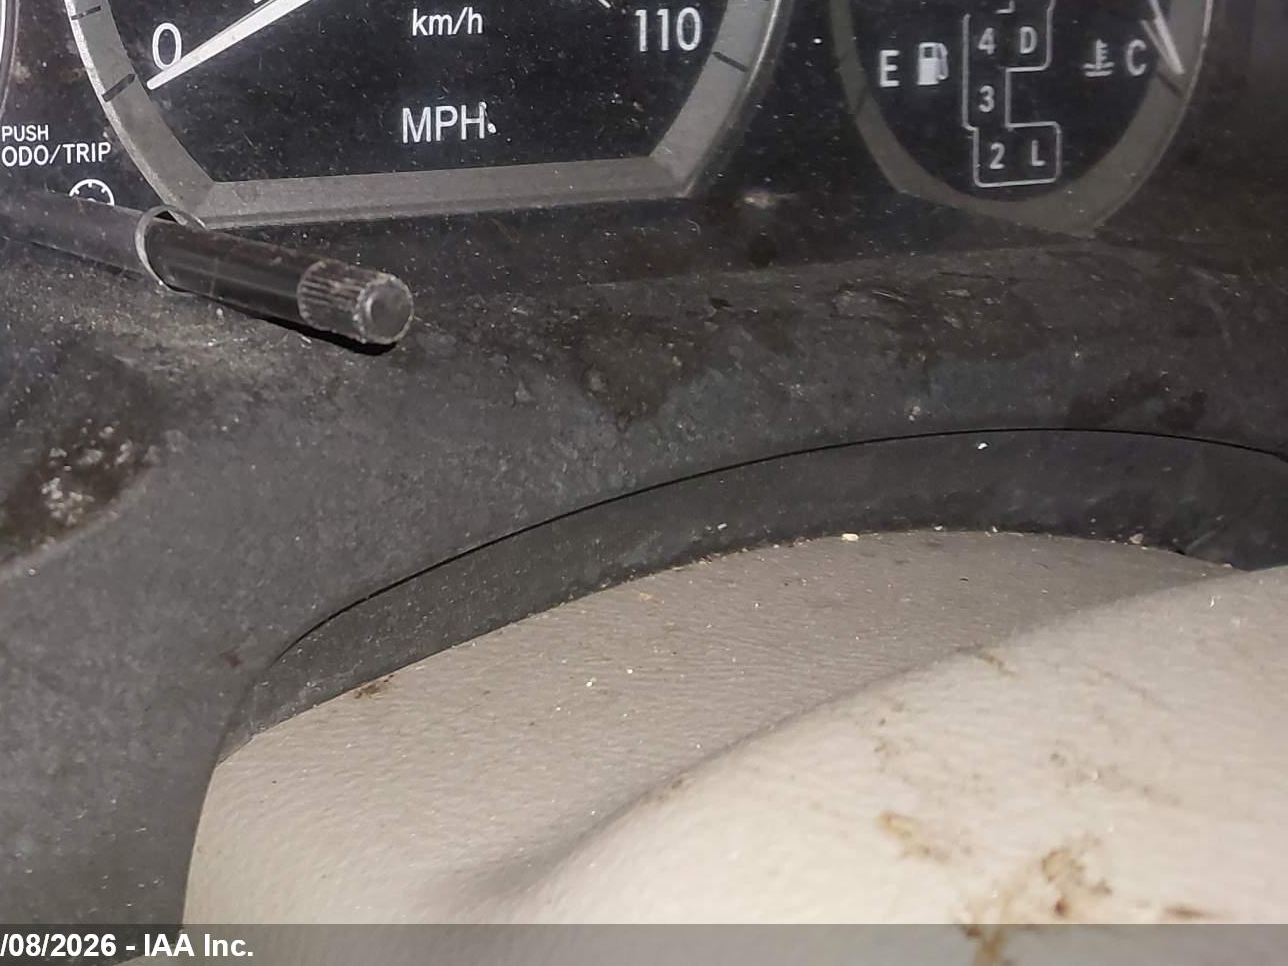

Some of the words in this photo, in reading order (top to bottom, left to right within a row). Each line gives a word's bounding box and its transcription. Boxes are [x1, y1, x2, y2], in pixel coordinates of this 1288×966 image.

[413, 7, 482, 35] km/h
[636, 7, 701, 51] 110
[153, 23, 182, 68] 0
[978, 28, 994, 54] 4
[1020, 27, 1036, 53] D
[880, 50, 899, 86] E
[1127, 40, 1146, 75] C
[979, 86, 993, 112] 3
[2, 125, 49, 142] PUSH
[403, 105, 486, 143] MPH
[2, 142, 111, 166] ODO/TRIP
[990, 143, 1004, 169] 2
[1032, 141, 1045, 166] L
